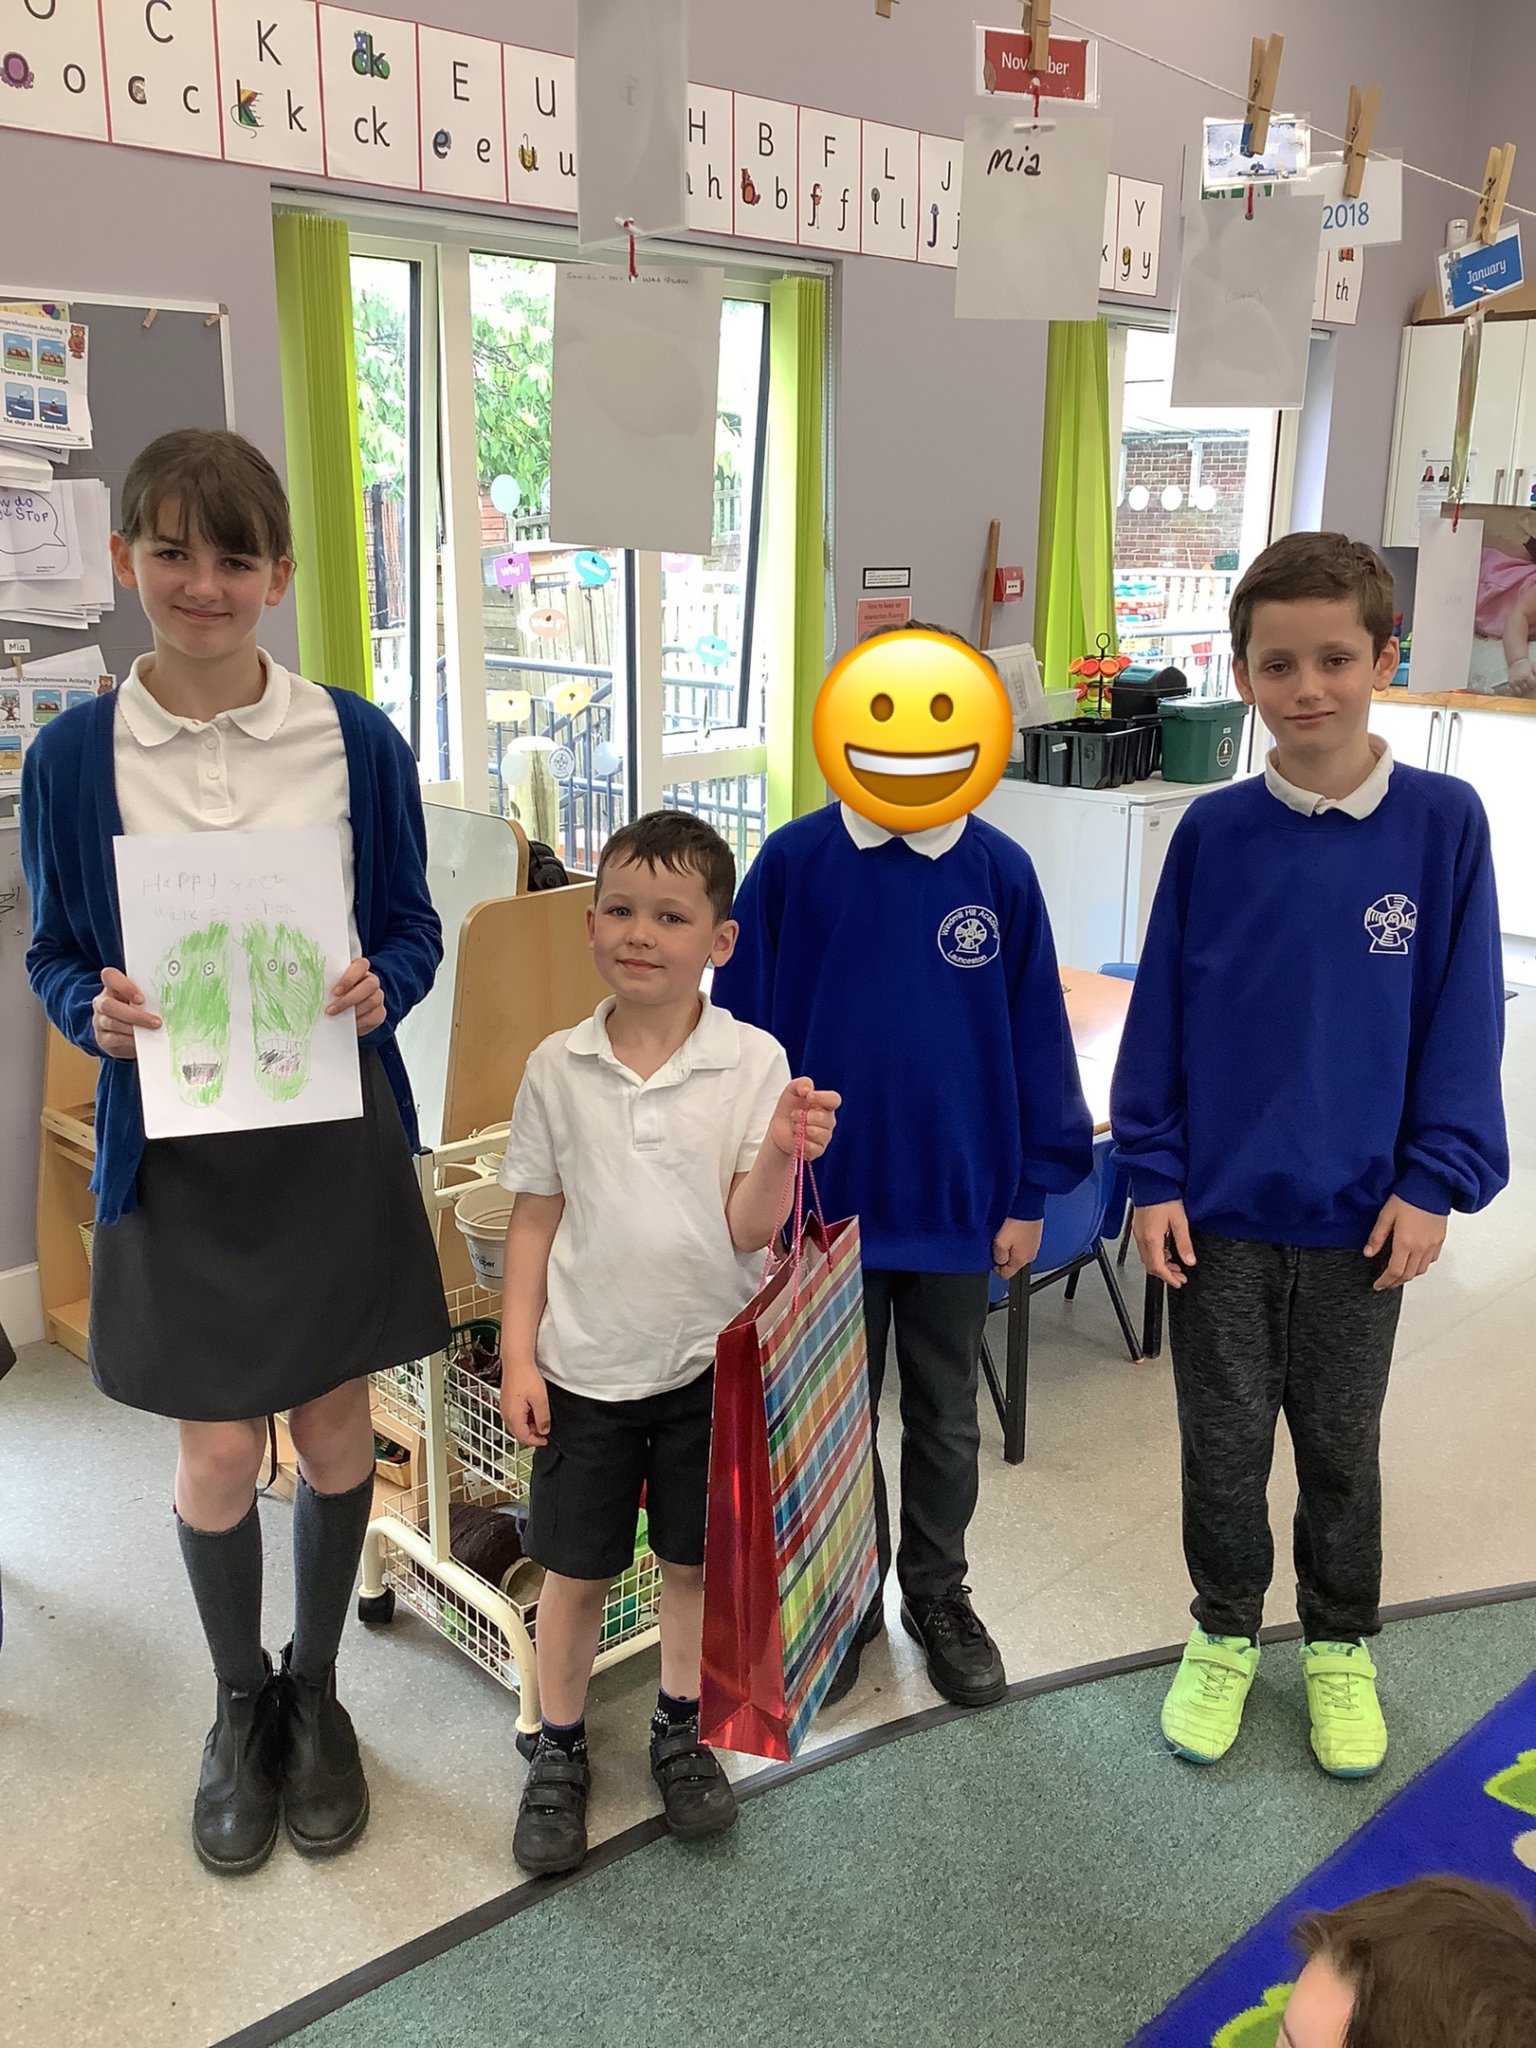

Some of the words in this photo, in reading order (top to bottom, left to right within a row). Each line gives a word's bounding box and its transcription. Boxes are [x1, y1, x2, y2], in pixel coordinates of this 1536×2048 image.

[145, 0, 174, 43] C
[257, 20, 282, 66] K
[63, 63, 86, 94] o
[1001, 51, 1070, 75] Novber
[453, 61, 470, 102] E
[536, 77, 556, 118] U
[182, 85, 201, 114] c
[287, 89, 307, 132] k
[354, 105, 390, 147] ck
[688, 108, 706, 145] H
[759, 122, 774, 157] B
[477, 138, 491, 163] e
[559, 151, 577, 177] u
[824, 135, 836, 167] F
[885, 147, 896, 180] L
[987, 145, 1041, 176] Mia
[708, 164, 722, 200] h
[941, 161, 951, 191] J
[776, 176, 788, 210] b
[837, 188, 849, 231] f
[1134, 199, 1145, 227] Y
[1322, 202, 1369, 229] 2018
[952, 212, 960, 250] j
[1142, 251, 1151, 280] y
[1466, 259, 1507, 285] January
[1335, 277, 1349, 301] th
[9, 643, 25, 651] Mia
